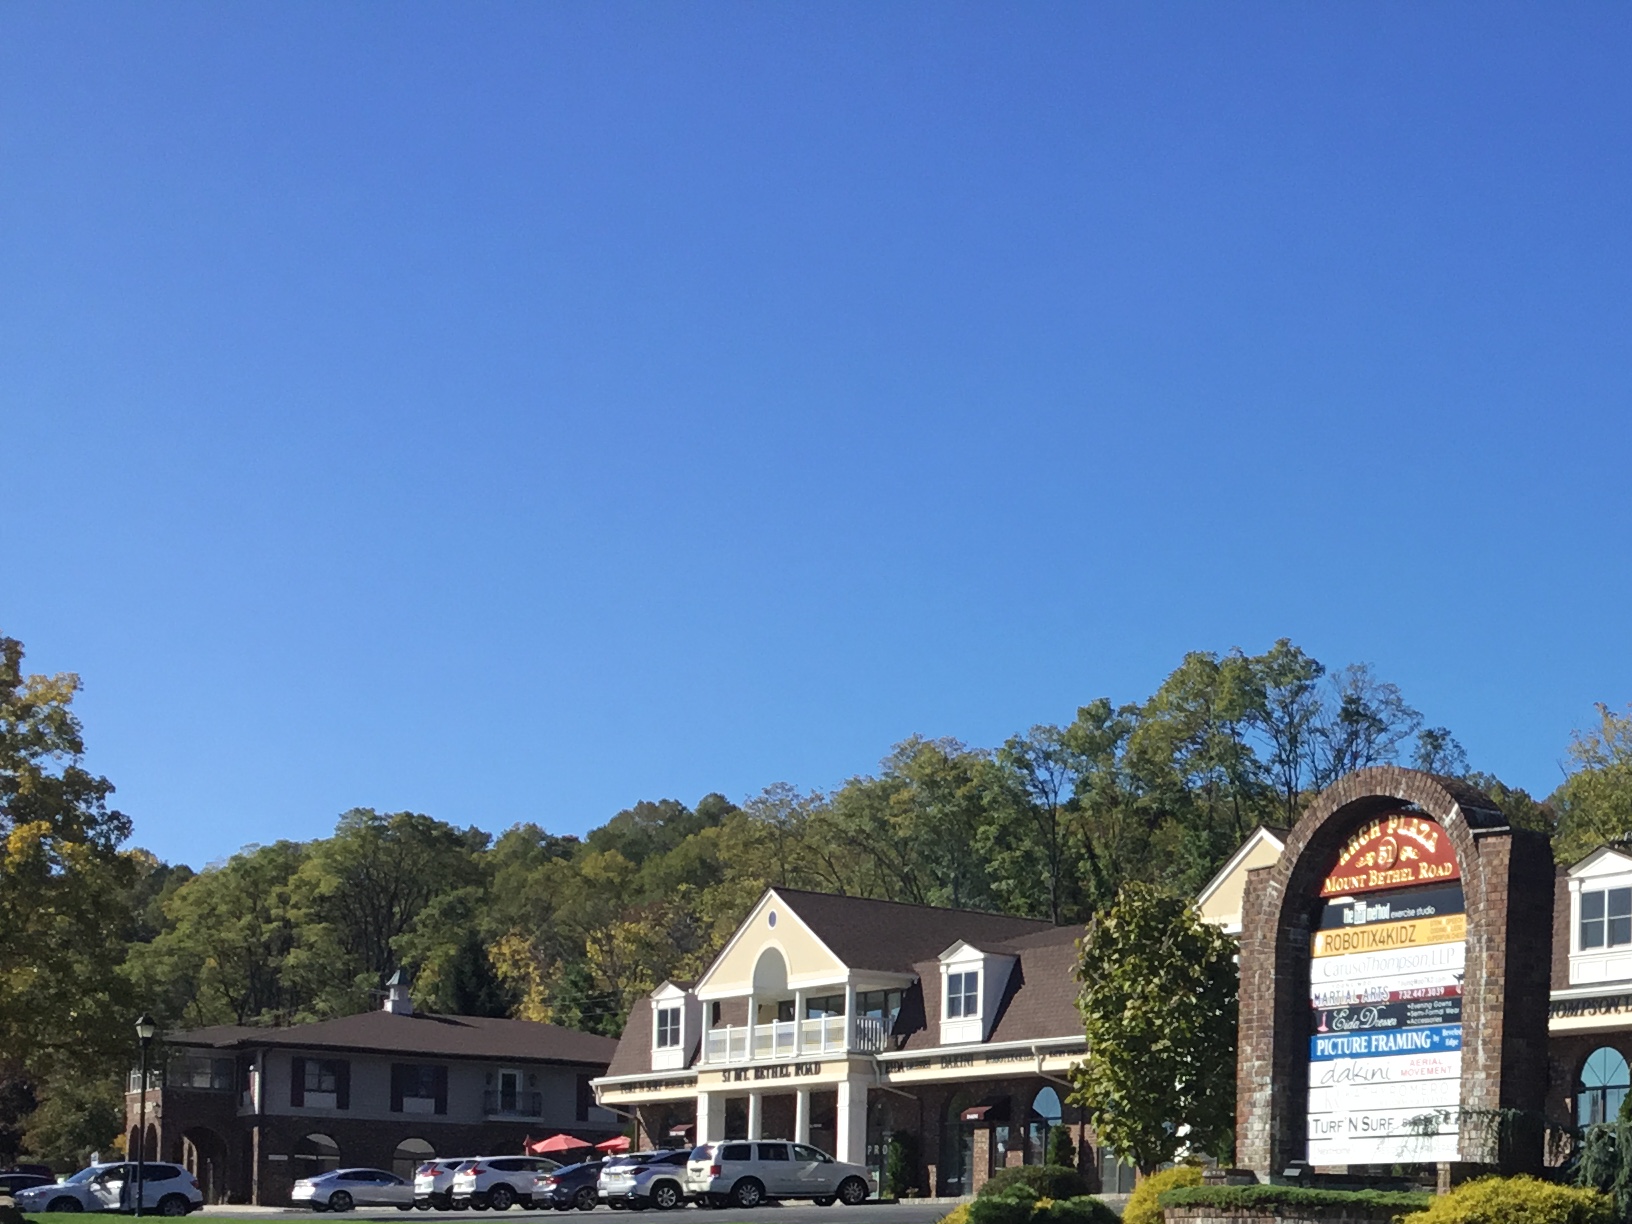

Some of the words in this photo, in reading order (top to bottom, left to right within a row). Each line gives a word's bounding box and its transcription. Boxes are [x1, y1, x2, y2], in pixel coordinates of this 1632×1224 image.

[1339, 819, 1381, 866] ARCH
[1387, 815, 1438, 853] PLAZA
[1378, 846, 1393, 865] 51
[1324, 874, 1367, 893] MOUNT
[1368, 868, 1415, 887] BETHEL
[1418, 862, 1453, 879] ROAD
[1343, 907, 1353, 924] the
[1367, 903, 1390, 921] method
[1390, 907, 1415, 919] exercise
[1416, 905, 1435, 916] studio
[1324, 924, 1417, 952] ROBOTIX4KIDZ
[1313, 989, 1359, 1008] MARTIAL
[1361, 985, 1390, 1004] ARTS
[1316, 1035, 1368, 1056] PICTURE
[1371, 1031, 1431, 1052] FRAMING
[753, 1064, 792, 1080] BETHEL
[794, 1061, 822, 1077] ROAD
[1320, 1061, 1392, 1085] dakini
[1400, 1066, 1452, 1077] MOVEMENT
[1410, 1058, 1443, 1067] AERIAL
[1313, 1119, 1344, 1134] TURF
[1362, 1116, 1395, 1132] SURF
